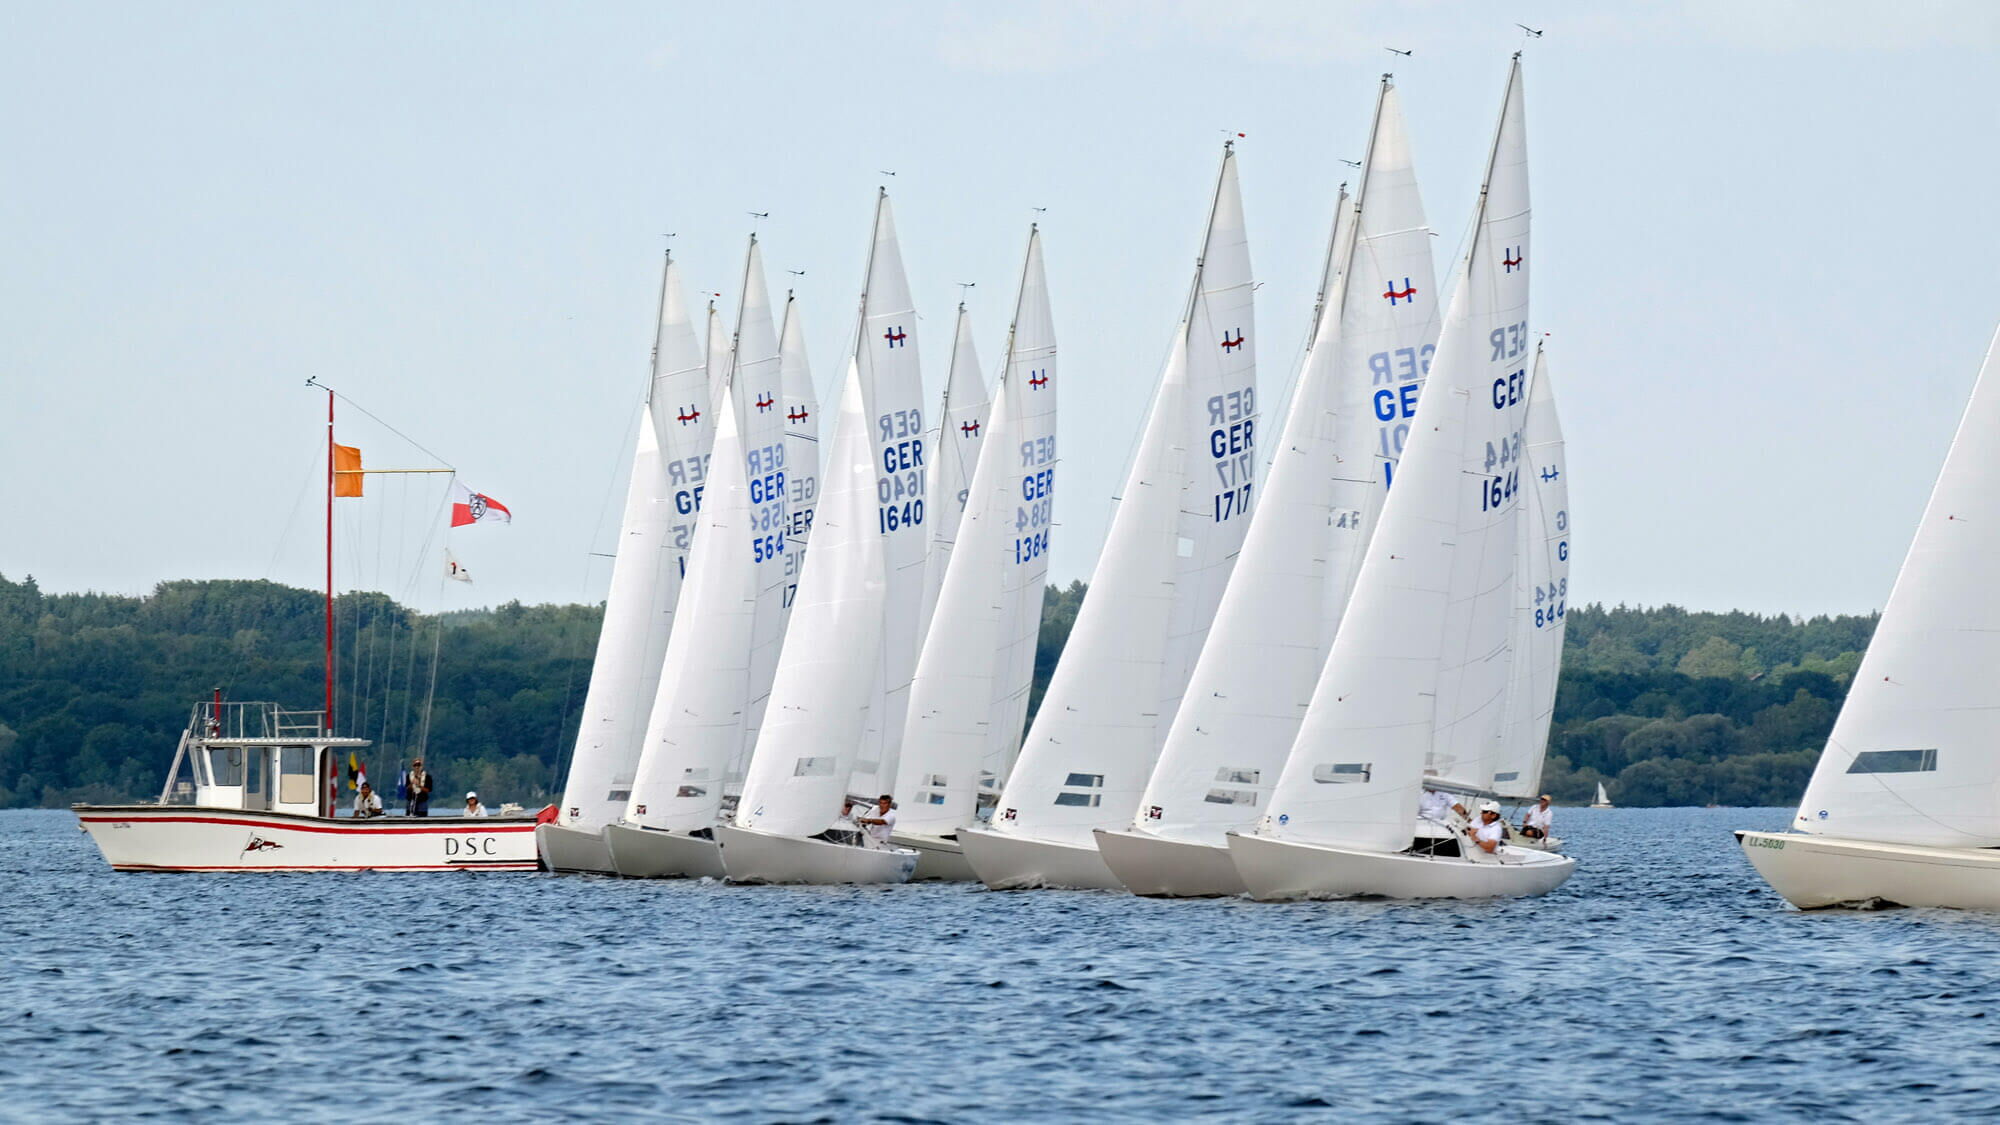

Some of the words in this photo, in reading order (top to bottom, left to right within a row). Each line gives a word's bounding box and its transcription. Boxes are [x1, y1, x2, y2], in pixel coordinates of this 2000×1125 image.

[1373, 384, 1420, 422] GE
[1492, 368, 1525, 410] GER
[884, 439, 923, 473] GER
[1210, 419, 1254, 459] GER
[675, 486, 705, 515] GE
[750, 472, 785, 505] GER
[1022, 468, 1054, 501] GER
[1482, 465, 1519, 512] 1644
[879, 499, 924, 534] 1640
[1215, 482, 1252, 523] 1717
[752, 531, 785, 564] 564
[1015, 528, 1049, 565] 1384
[1558, 541, 1568, 562] G
[1535, 600, 1565, 629] 844
[444, 837, 497, 856] DSC
